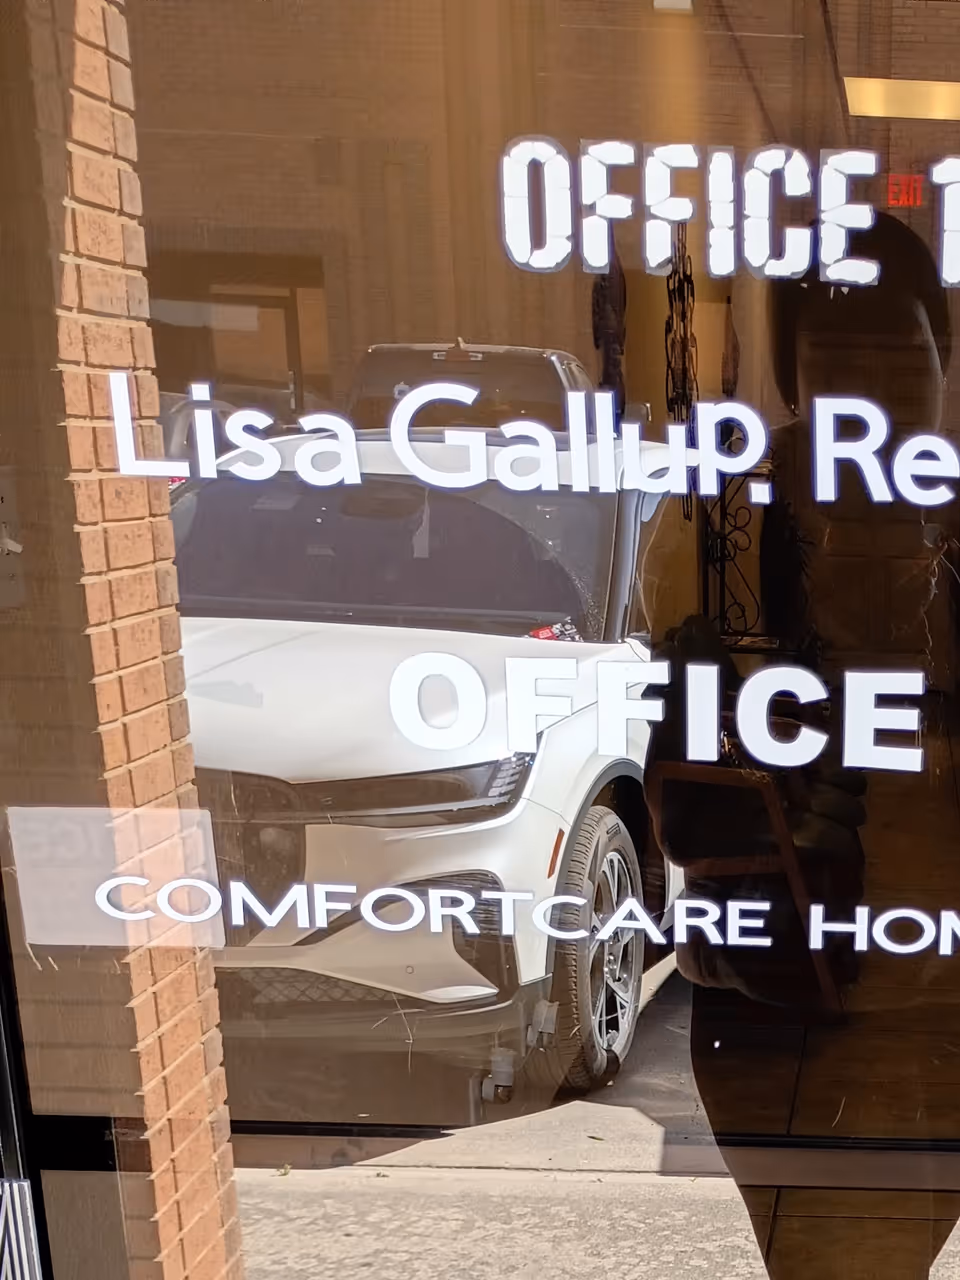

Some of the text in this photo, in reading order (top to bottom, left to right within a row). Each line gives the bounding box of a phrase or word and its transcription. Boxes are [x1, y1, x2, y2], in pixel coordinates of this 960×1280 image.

[502, 138, 878, 286] OFFICE
[888, 174, 924, 207] EXIT
[108, 371, 363, 489] Lisa
[388, 382, 771, 504] Gallup.
[388, 651, 926, 773] OFFICE
[94, 874, 773, 948] COMFORTCARE
